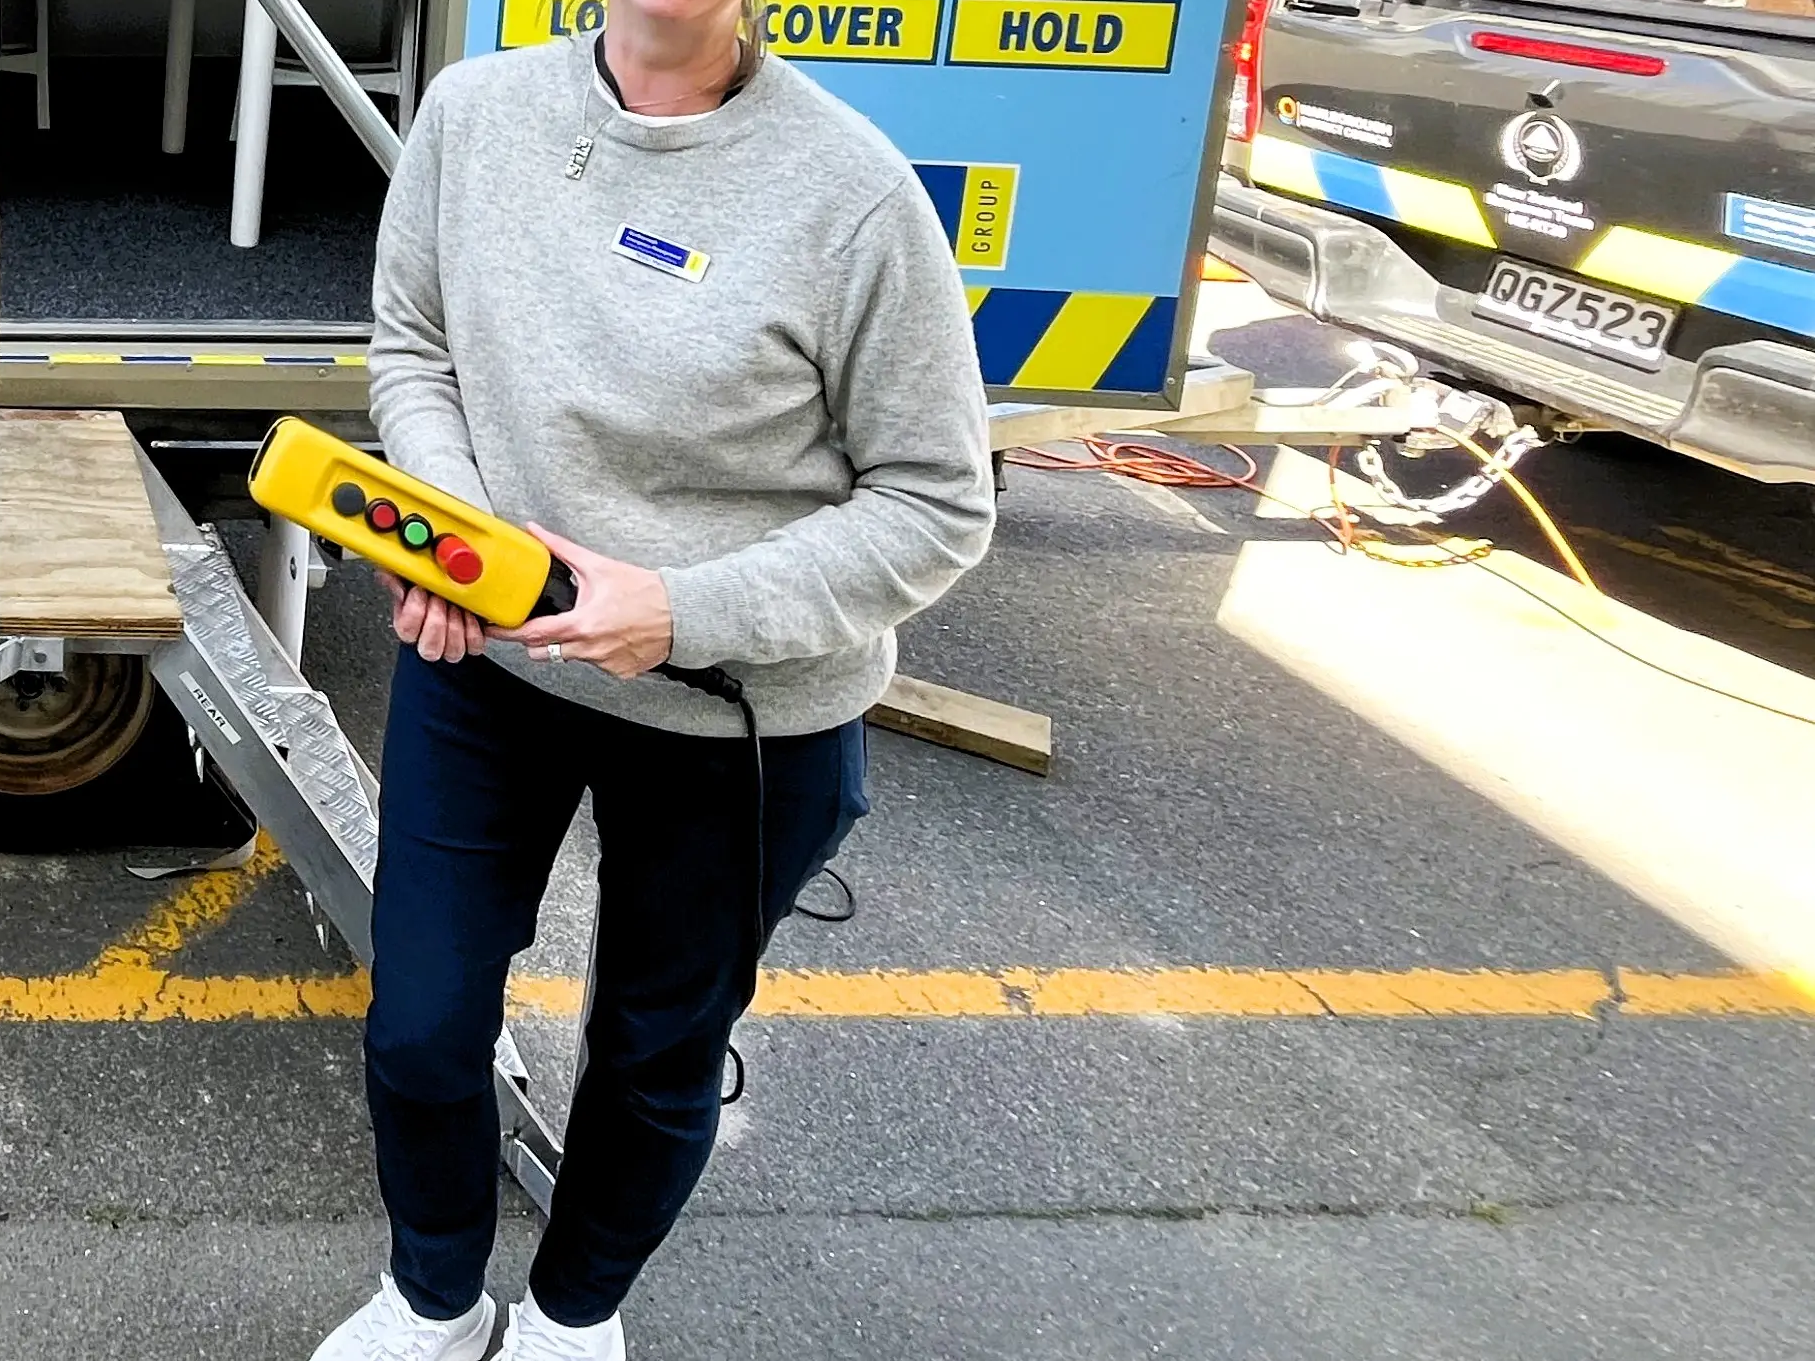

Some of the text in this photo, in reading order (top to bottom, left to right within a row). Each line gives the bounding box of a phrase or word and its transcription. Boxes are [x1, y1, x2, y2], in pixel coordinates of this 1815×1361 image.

[765, 2, 904, 47] COVER
[999, 11, 1125, 55] HOLD
[971, 178, 1001, 254] GROUP
[1491, 267, 1667, 350] QGZ523
[192, 687, 227, 728] REAR
